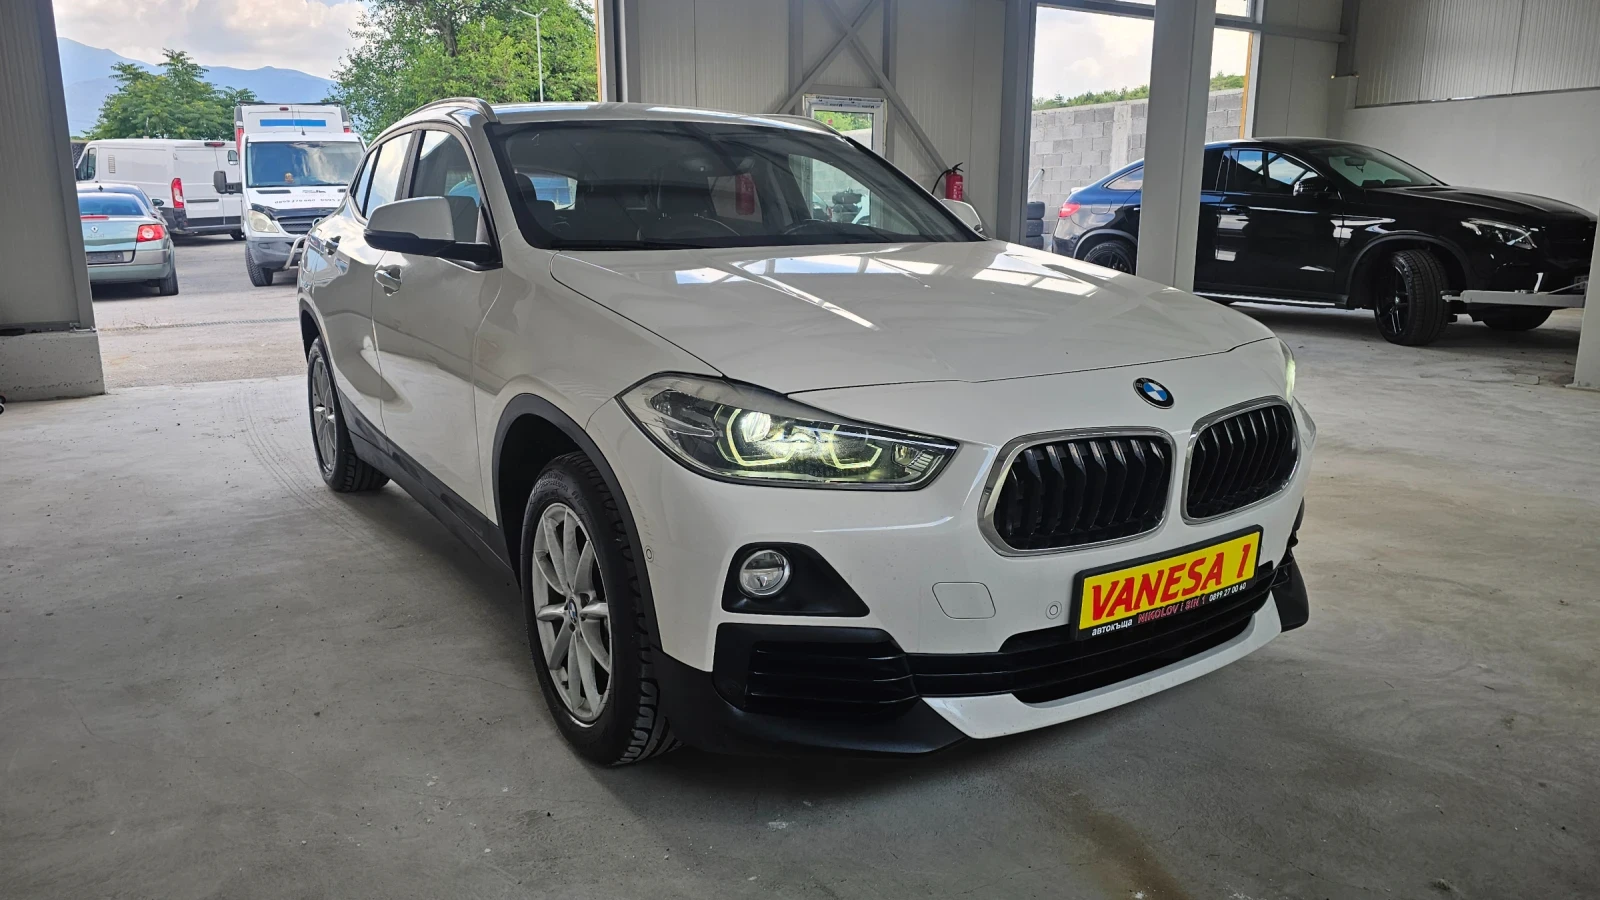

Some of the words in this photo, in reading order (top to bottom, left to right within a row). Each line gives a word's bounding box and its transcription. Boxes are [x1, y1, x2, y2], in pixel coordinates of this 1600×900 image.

[1092, 552, 1224, 620] VANESA
[1138, 604, 1180, 623] NIKOLOV
[1209, 591, 1224, 602] 0899
[1223, 587, 1232, 597] 27
[1231, 585, 1239, 594] 00
[1239, 582, 1247, 591] 60
[1092, 619, 1133, 636] автокъща
